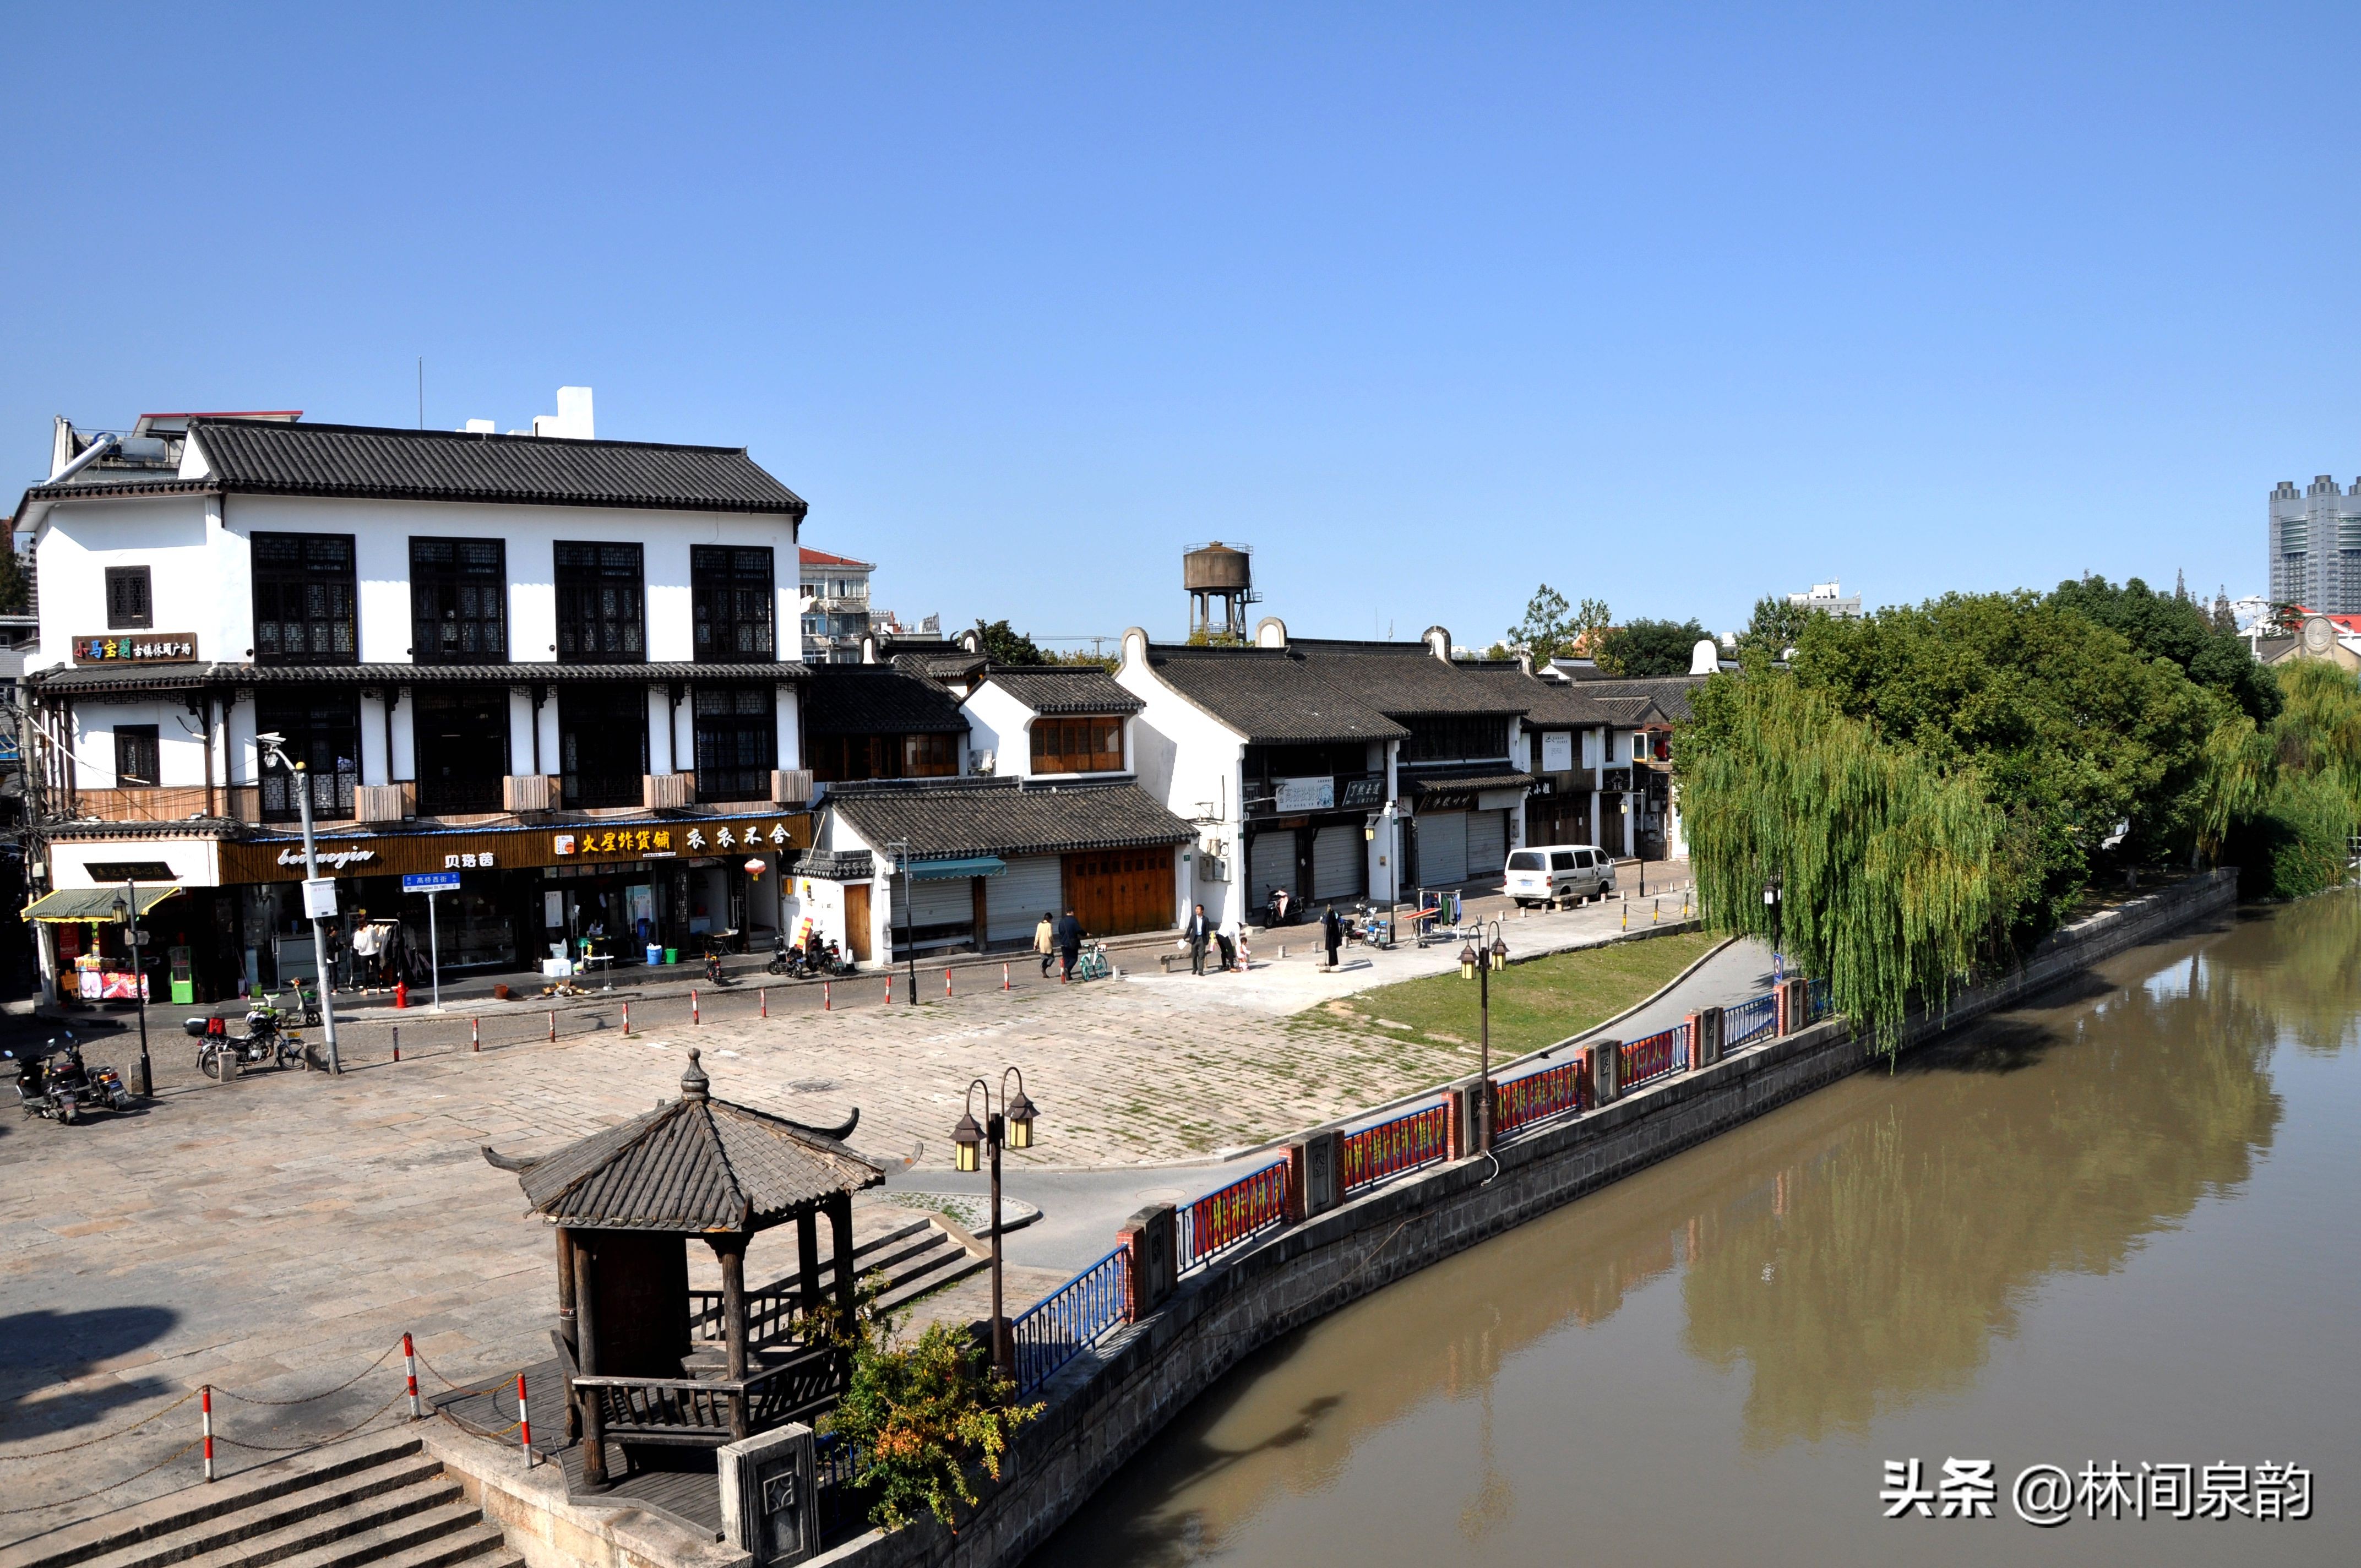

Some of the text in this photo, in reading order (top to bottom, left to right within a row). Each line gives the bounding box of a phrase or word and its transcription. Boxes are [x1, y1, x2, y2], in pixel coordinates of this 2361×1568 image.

[1528, 782, 1551, 796] 小姐
[582, 830, 670, 852] 火星炸货铺
[687, 823, 791, 850] 衣衣不舍
[445, 852, 494, 868] 贝珞茵
[417, 876, 447, 884] 高桥西街
